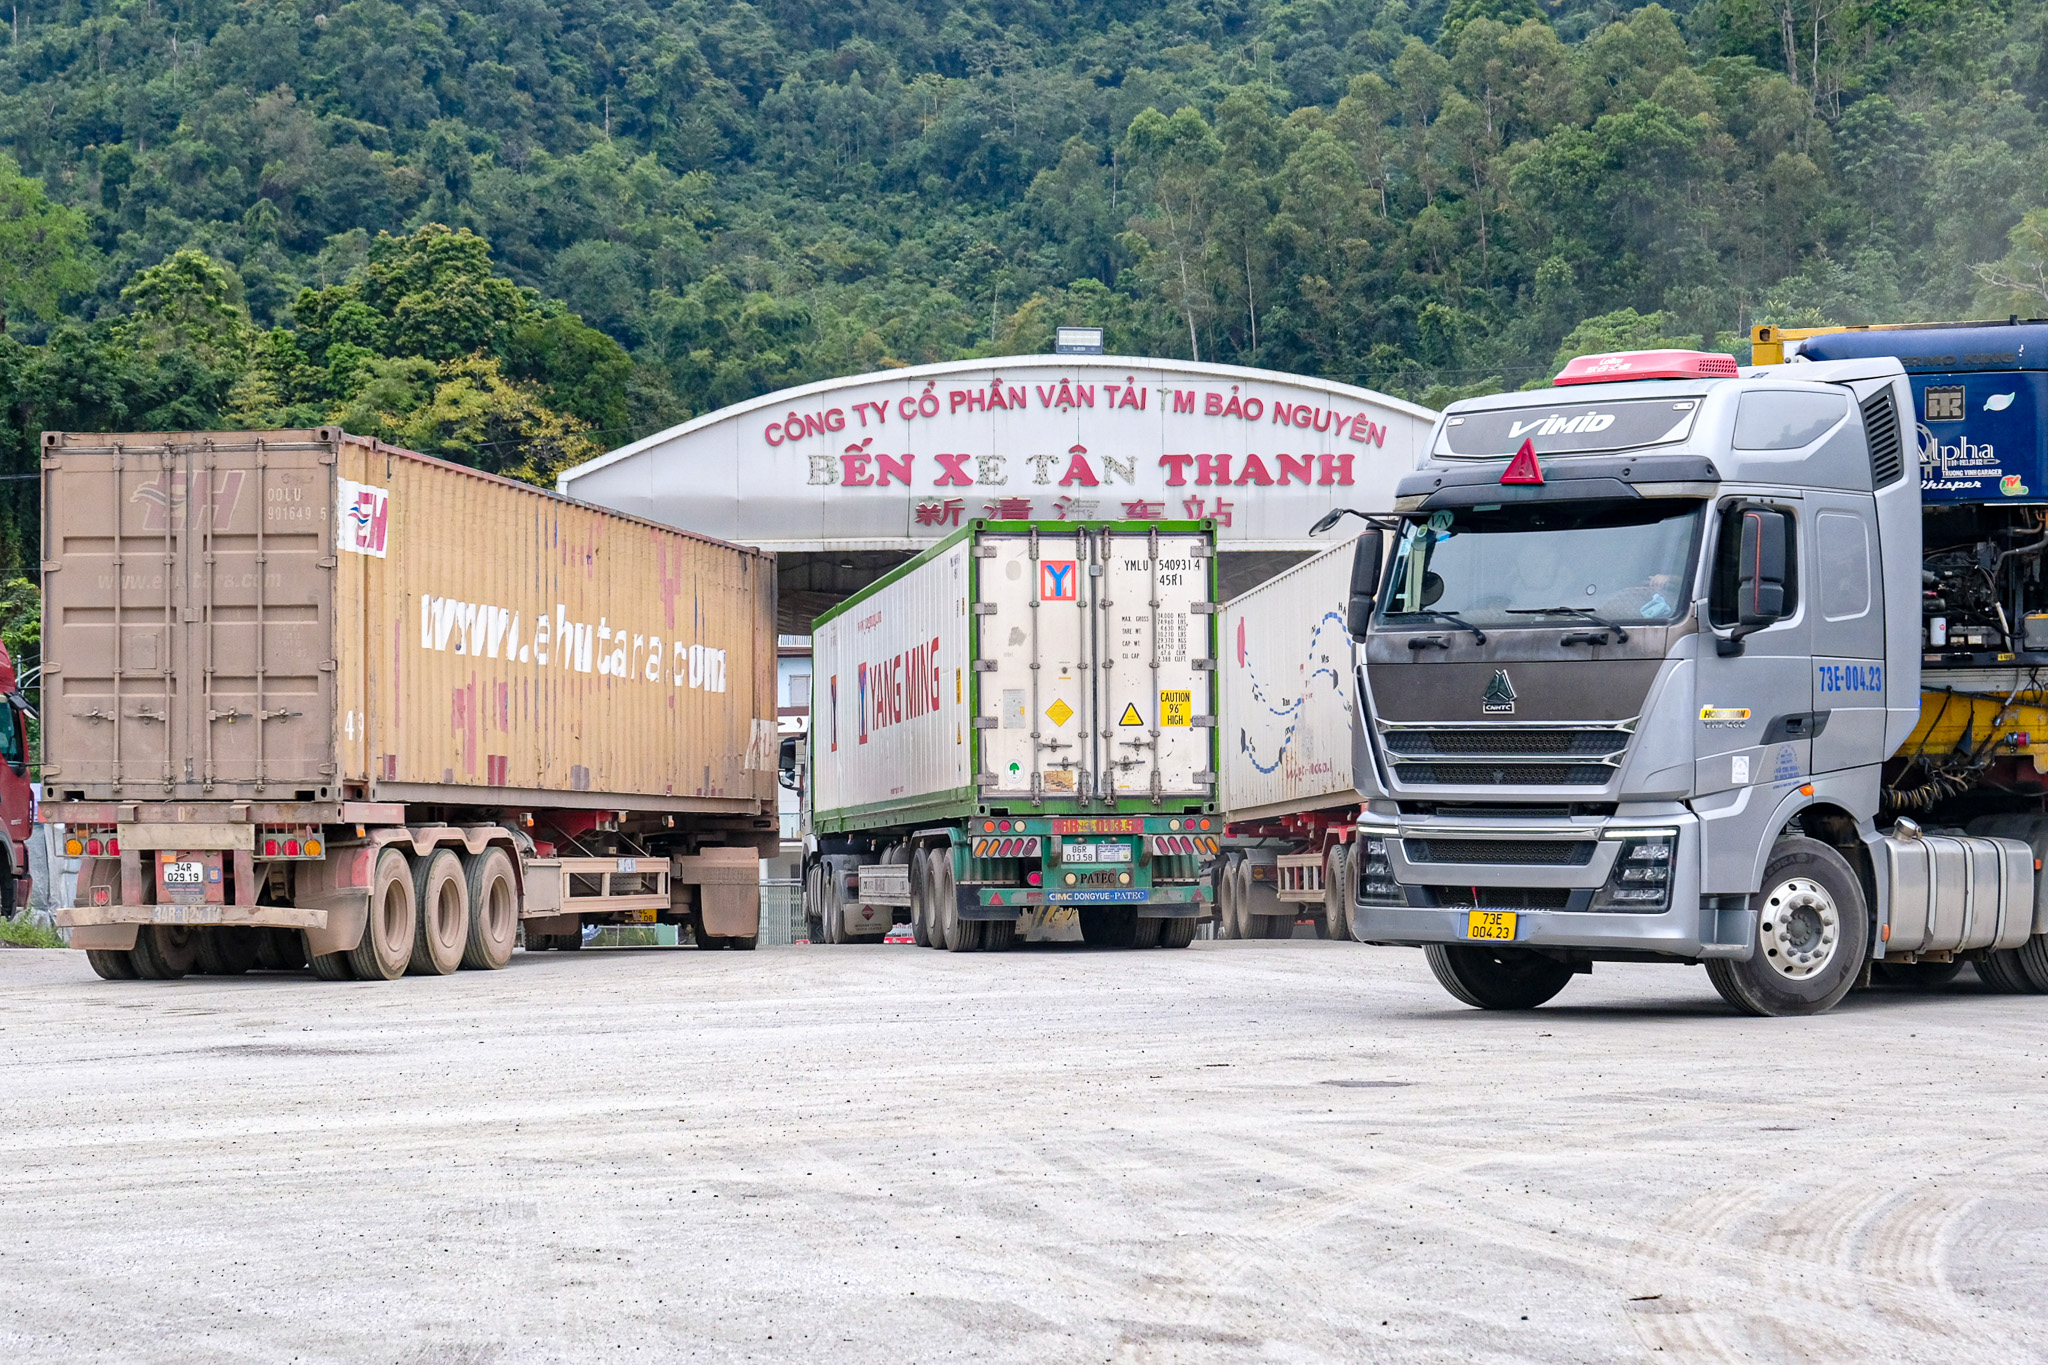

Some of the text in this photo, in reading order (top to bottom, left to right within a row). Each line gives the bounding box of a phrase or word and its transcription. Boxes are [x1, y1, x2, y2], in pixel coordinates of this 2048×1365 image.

[765, 411, 846, 446] CÔNG
[852, 400, 890, 426] TY
[898, 380, 940, 420] CỔ
[950, 378, 1026, 414] PHẦN
[1036, 378, 1094, 412] VẬN
[1104, 376, 1147, 410] TẢI
[1204, 385, 1264, 420] BẢO
[1273, 401, 1386, 448] NGUYÊN
[807, 438, 1355, 486] BẾN XE TÂN THANH
[2004, 476, 2020, 488] TV
[268, 507, 312, 522] 901649
[1431, 514, 1452, 528] VN
[1124, 560, 1149, 571] YMLU
[1159, 574, 1182, 586] 45R1
[870, 654, 902, 731] YANG
[906, 636, 940, 720] MING
[1818, 666, 1882, 692] 73E-004.23
[1160, 692, 1190, 702] CAUTION
[1167, 715, 1184, 725] HIGH
[174, 863, 192, 872] 34R
[168, 873, 199, 882] 029.19
[1080, 873, 1115, 884] PATEC
[1483, 913, 1502, 925] 73E
[1472, 926, 1509, 938] 004.23
